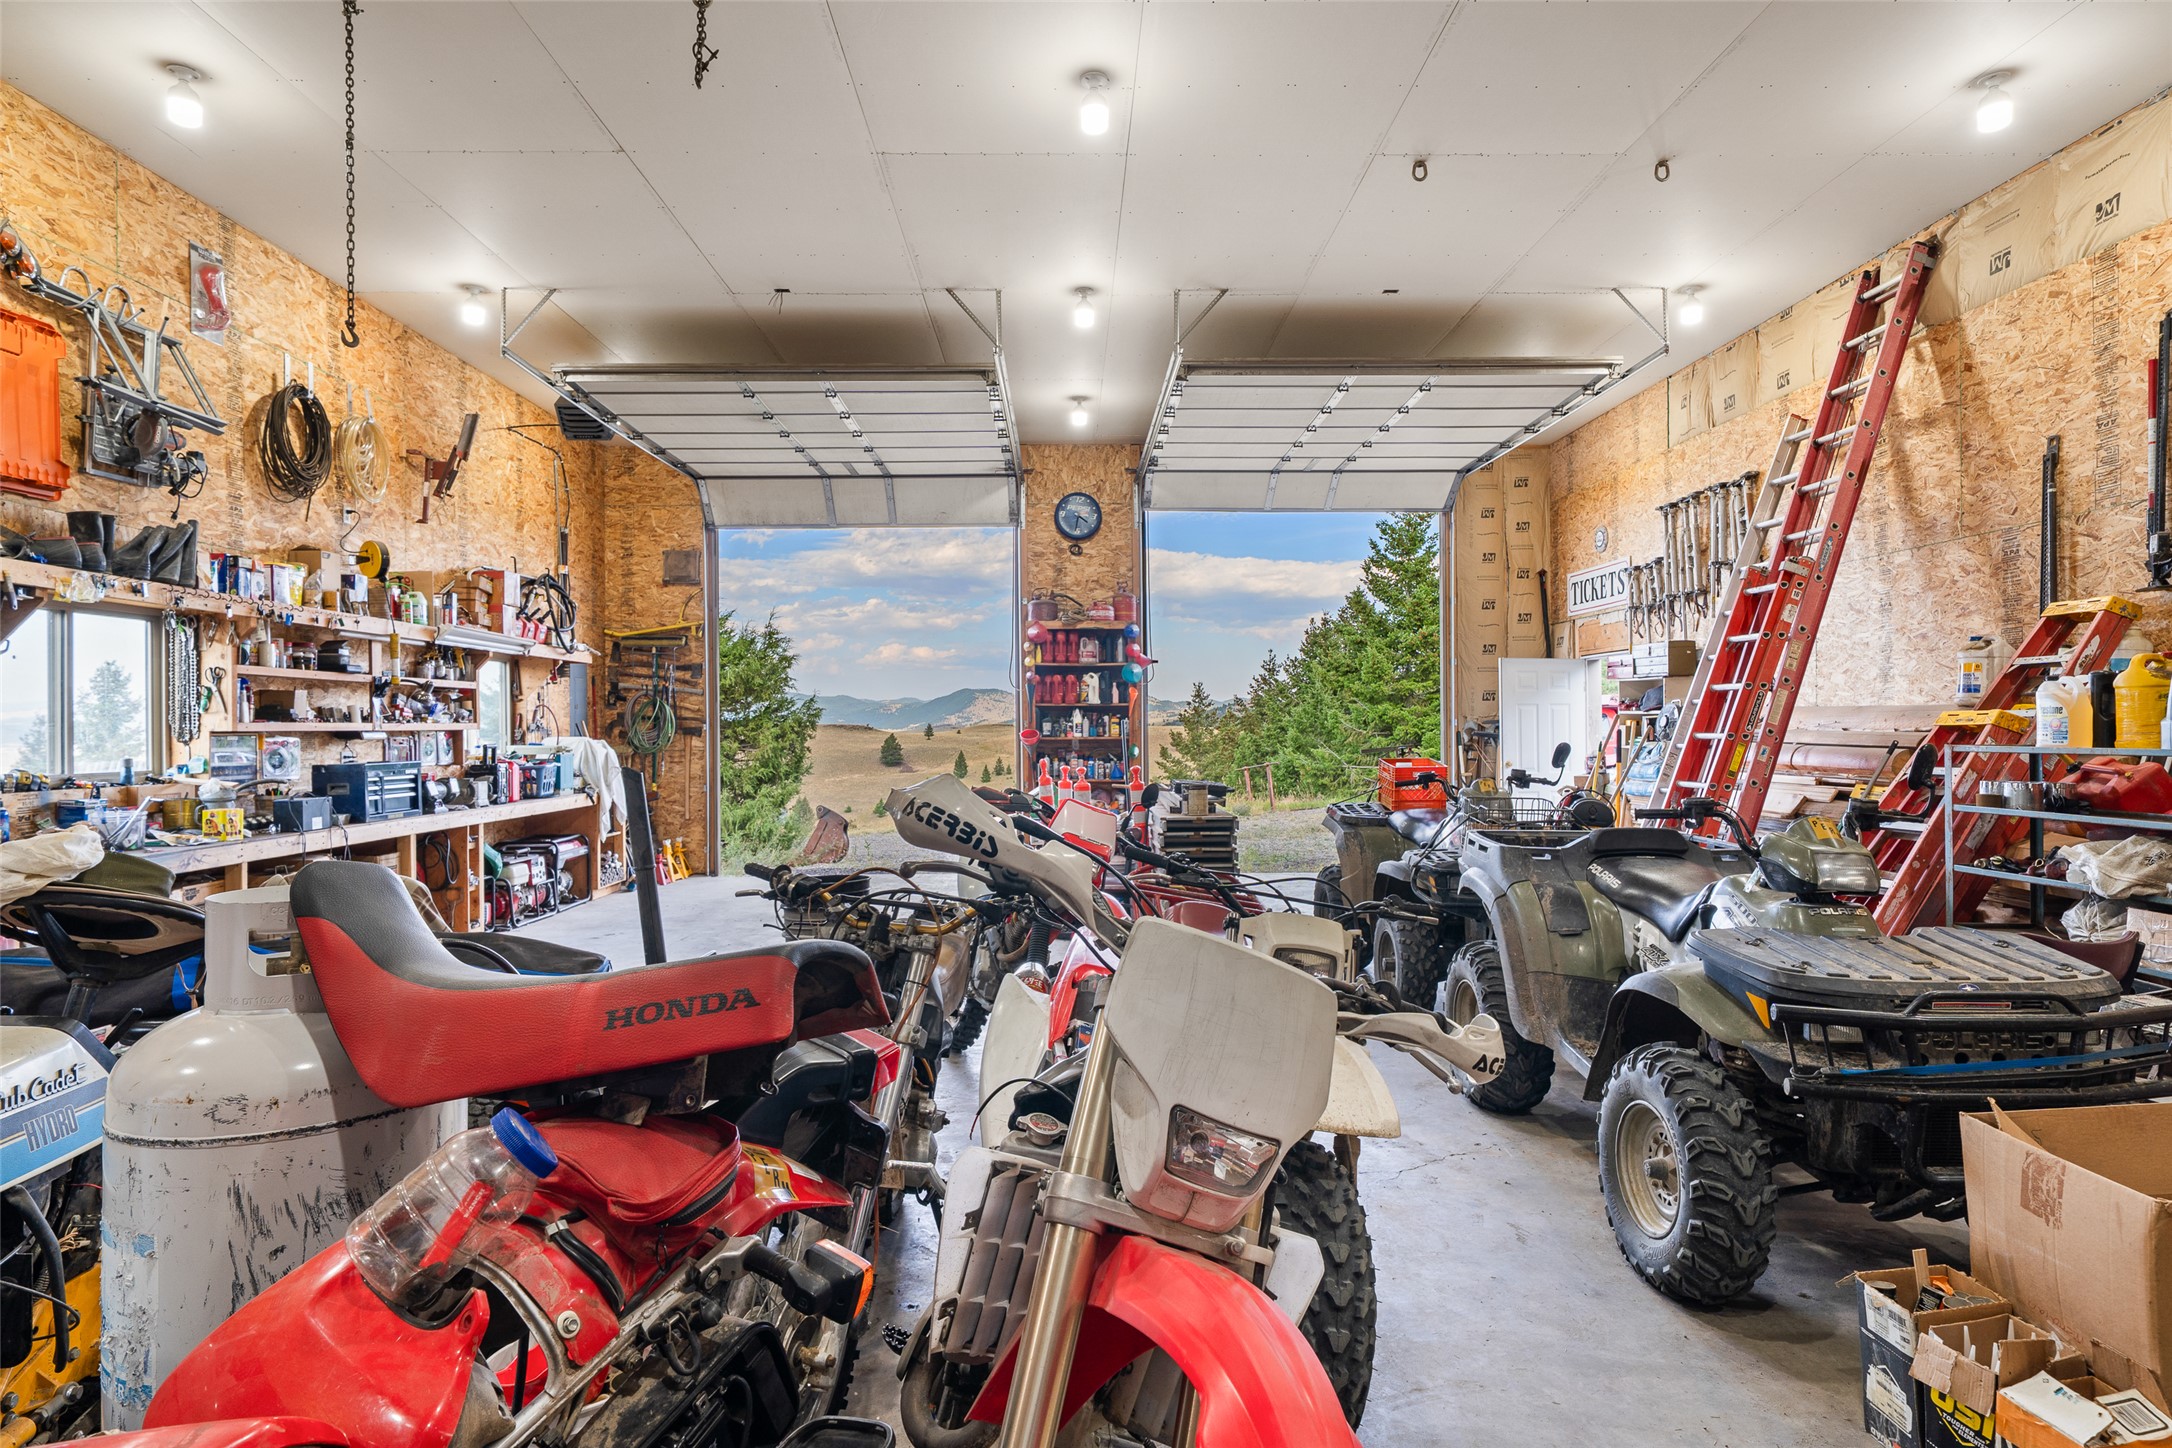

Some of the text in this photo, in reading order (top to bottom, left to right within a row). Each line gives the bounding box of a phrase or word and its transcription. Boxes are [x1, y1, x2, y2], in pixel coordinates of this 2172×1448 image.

[1570, 570, 1625, 606] TICKETS
[1587, 863, 1621, 889] POLARIS
[1808, 907, 1868, 917] POLARIS
[603, 987, 761, 1031] HONDA
[28, 1062, 87, 1102] Cadet
[23, 1104, 80, 1153] HYDRO
[1942, 1411, 1975, 1437] TOUGHER
